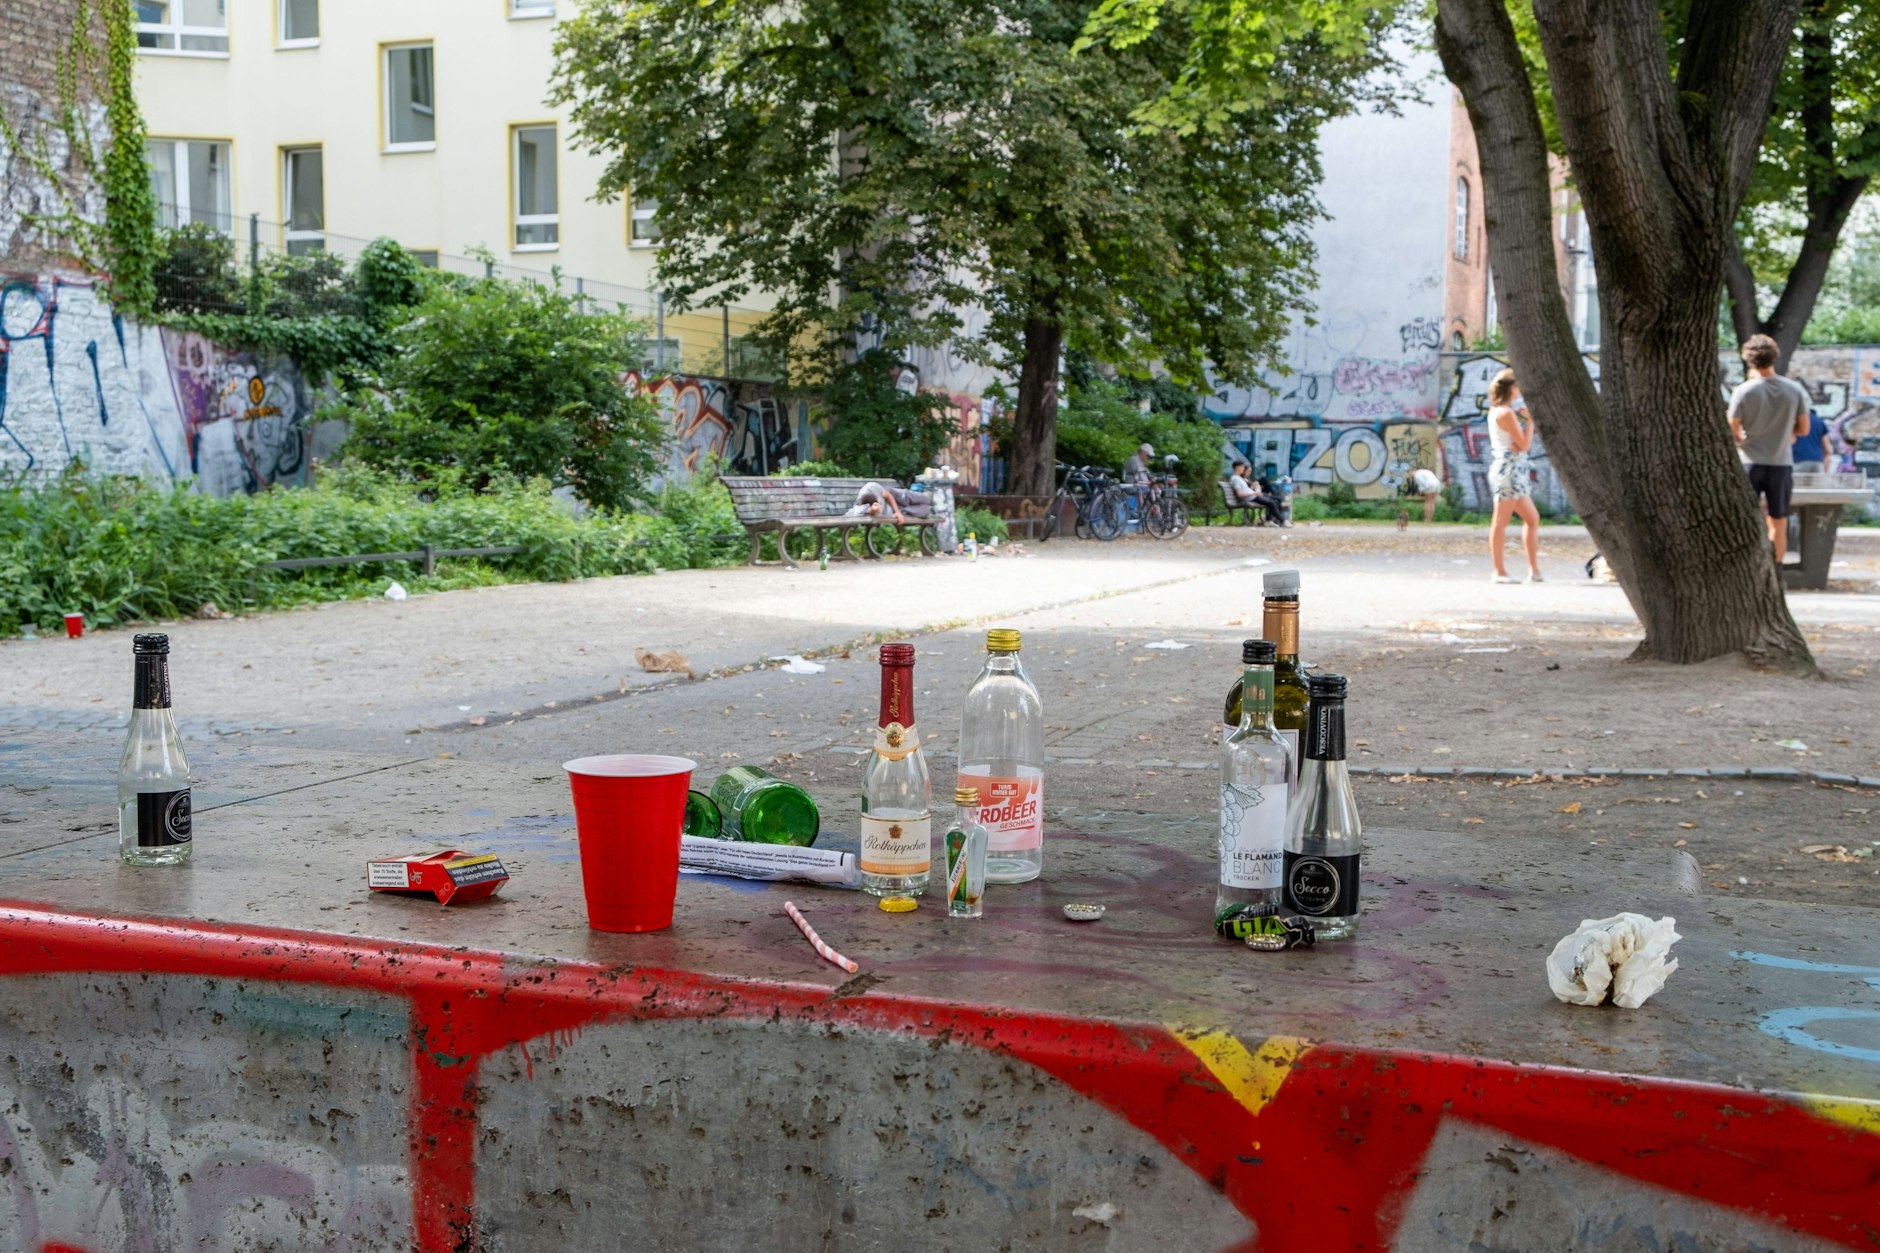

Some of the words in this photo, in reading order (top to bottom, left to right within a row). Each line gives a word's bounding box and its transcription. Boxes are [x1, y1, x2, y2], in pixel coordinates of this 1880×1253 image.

[1318, 708, 1327, 755] VESCOVINO
[864, 835, 927, 855] Rotkäppchen
[1233, 852, 1243, 860] LE
[1233, 860, 1281, 875] BLANC
[1294, 876, 1330, 895] Secco
